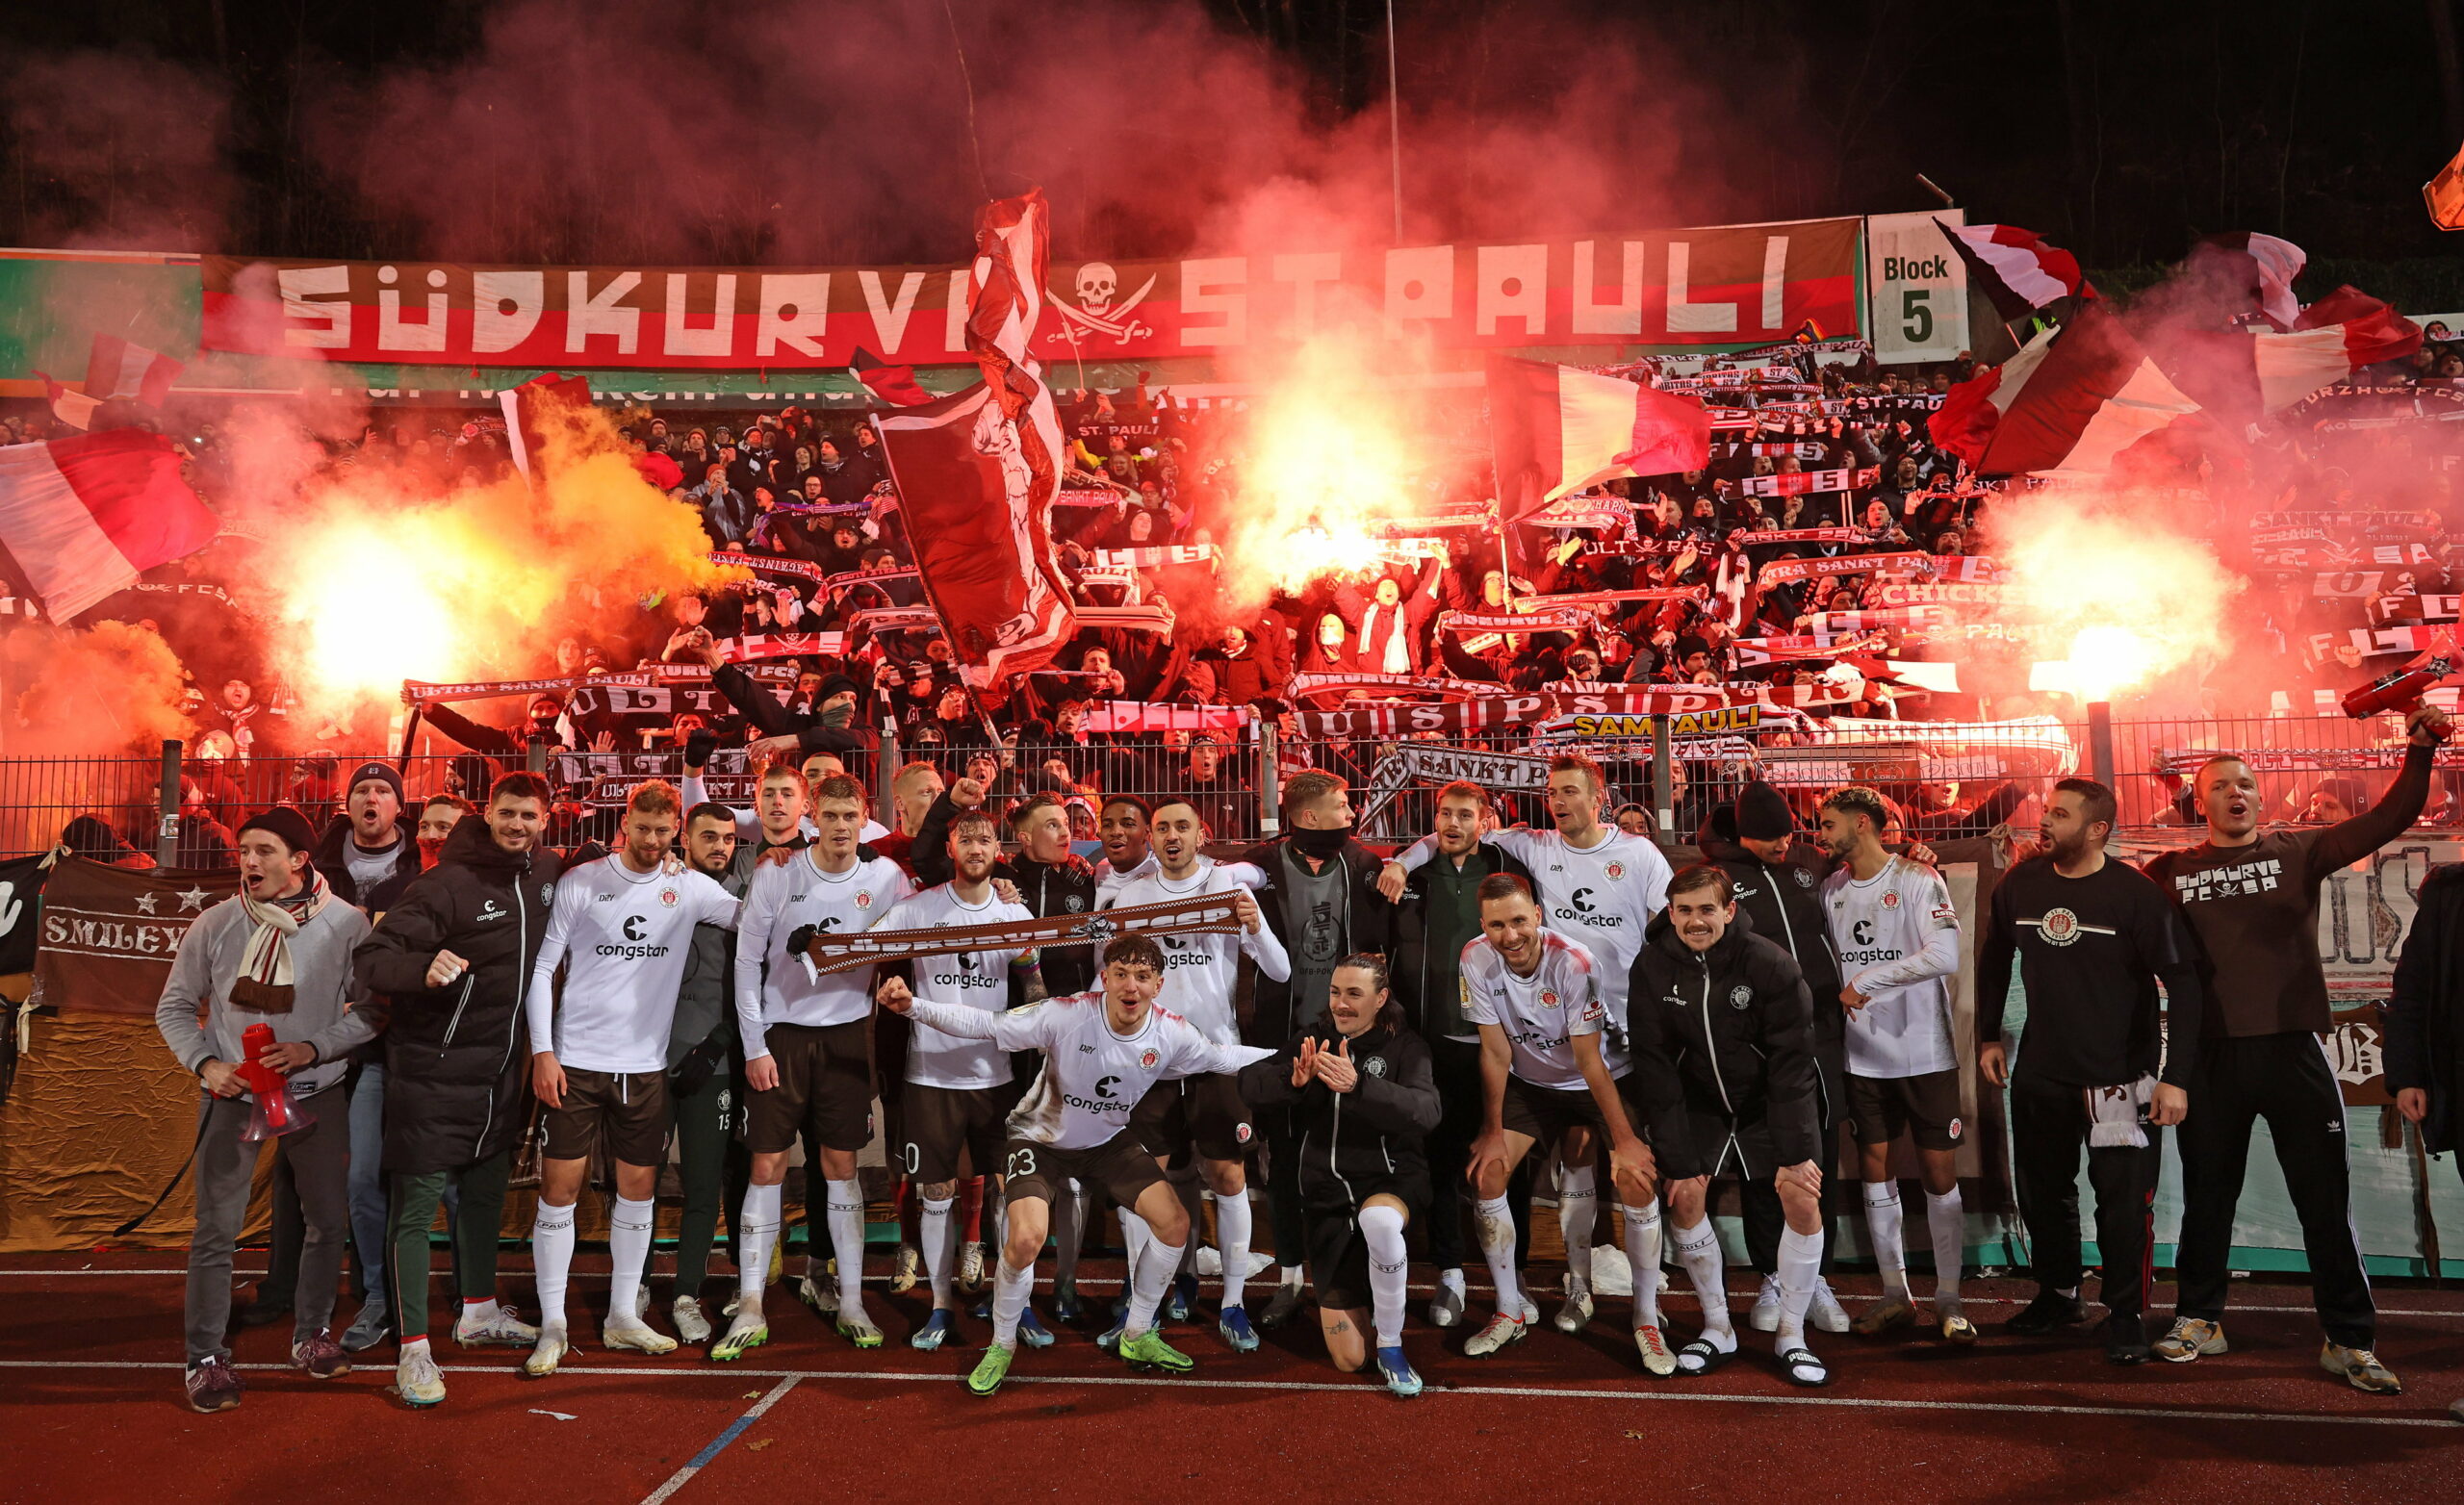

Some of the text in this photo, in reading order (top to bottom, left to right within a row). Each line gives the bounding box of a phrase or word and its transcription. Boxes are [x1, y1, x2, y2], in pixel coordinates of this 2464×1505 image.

[1884, 254, 1948, 280] Block
[278, 265, 969, 357] SÜDKURV
[1384, 236, 1789, 341] PAULI
[1902, 290, 1933, 343] 5
[1859, 395, 1942, 411] ST. PAU
[1060, 491, 1091, 502] SANKT
[1816, 556, 1886, 571] SANKT
[1881, 583, 2031, 604] CHICKE
[499, 676, 578, 692] SANKT
[585, 672, 652, 687] PAULI
[1420, 753, 1521, 784] SANKT
[2175, 858, 2282, 890] SÜDKURVE
[2182, 877, 2278, 904] FC SP
[476, 909, 507, 922] congstar
[1554, 907, 1623, 928] congstar
[596, 943, 669, 961] congstar
[934, 973, 999, 989] congstar
[718, 1112, 731, 1131] 15
[1006, 1148, 1037, 1185] 23
[1788, 1349, 1822, 1365] PUMA
